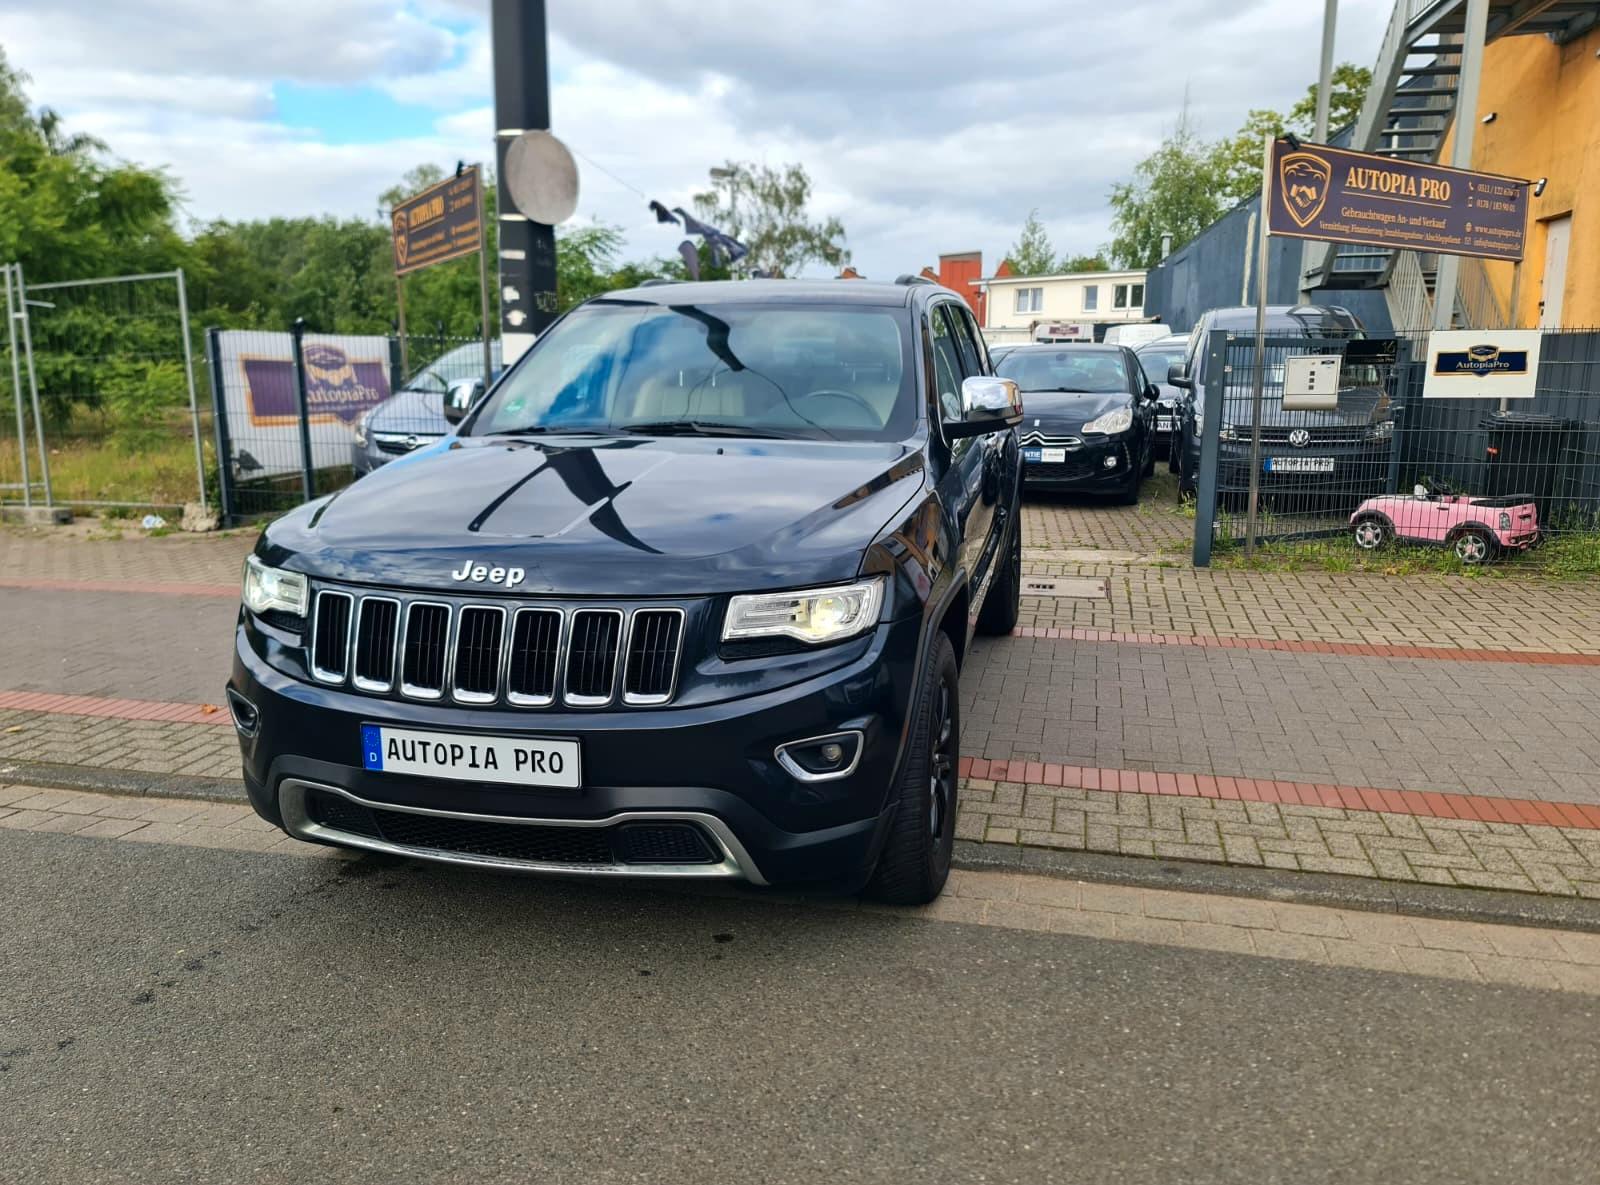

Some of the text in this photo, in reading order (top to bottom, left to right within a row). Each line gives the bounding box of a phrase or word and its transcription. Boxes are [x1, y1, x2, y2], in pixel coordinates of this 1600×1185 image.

[1345, 166, 1451, 201] AUTOPIA PRO
[1341, 206, 1396, 224] Gebrauchtwagen
[1409, 216, 1422, 226] und
[1422, 216, 1447, 229] Verkauf
[1456, 361, 1510, 369] AutopiaPro
[452, 560, 526, 588] Jeep
[370, 751, 377, 762] D
[387, 737, 564, 774] AUTOPIA PRO
